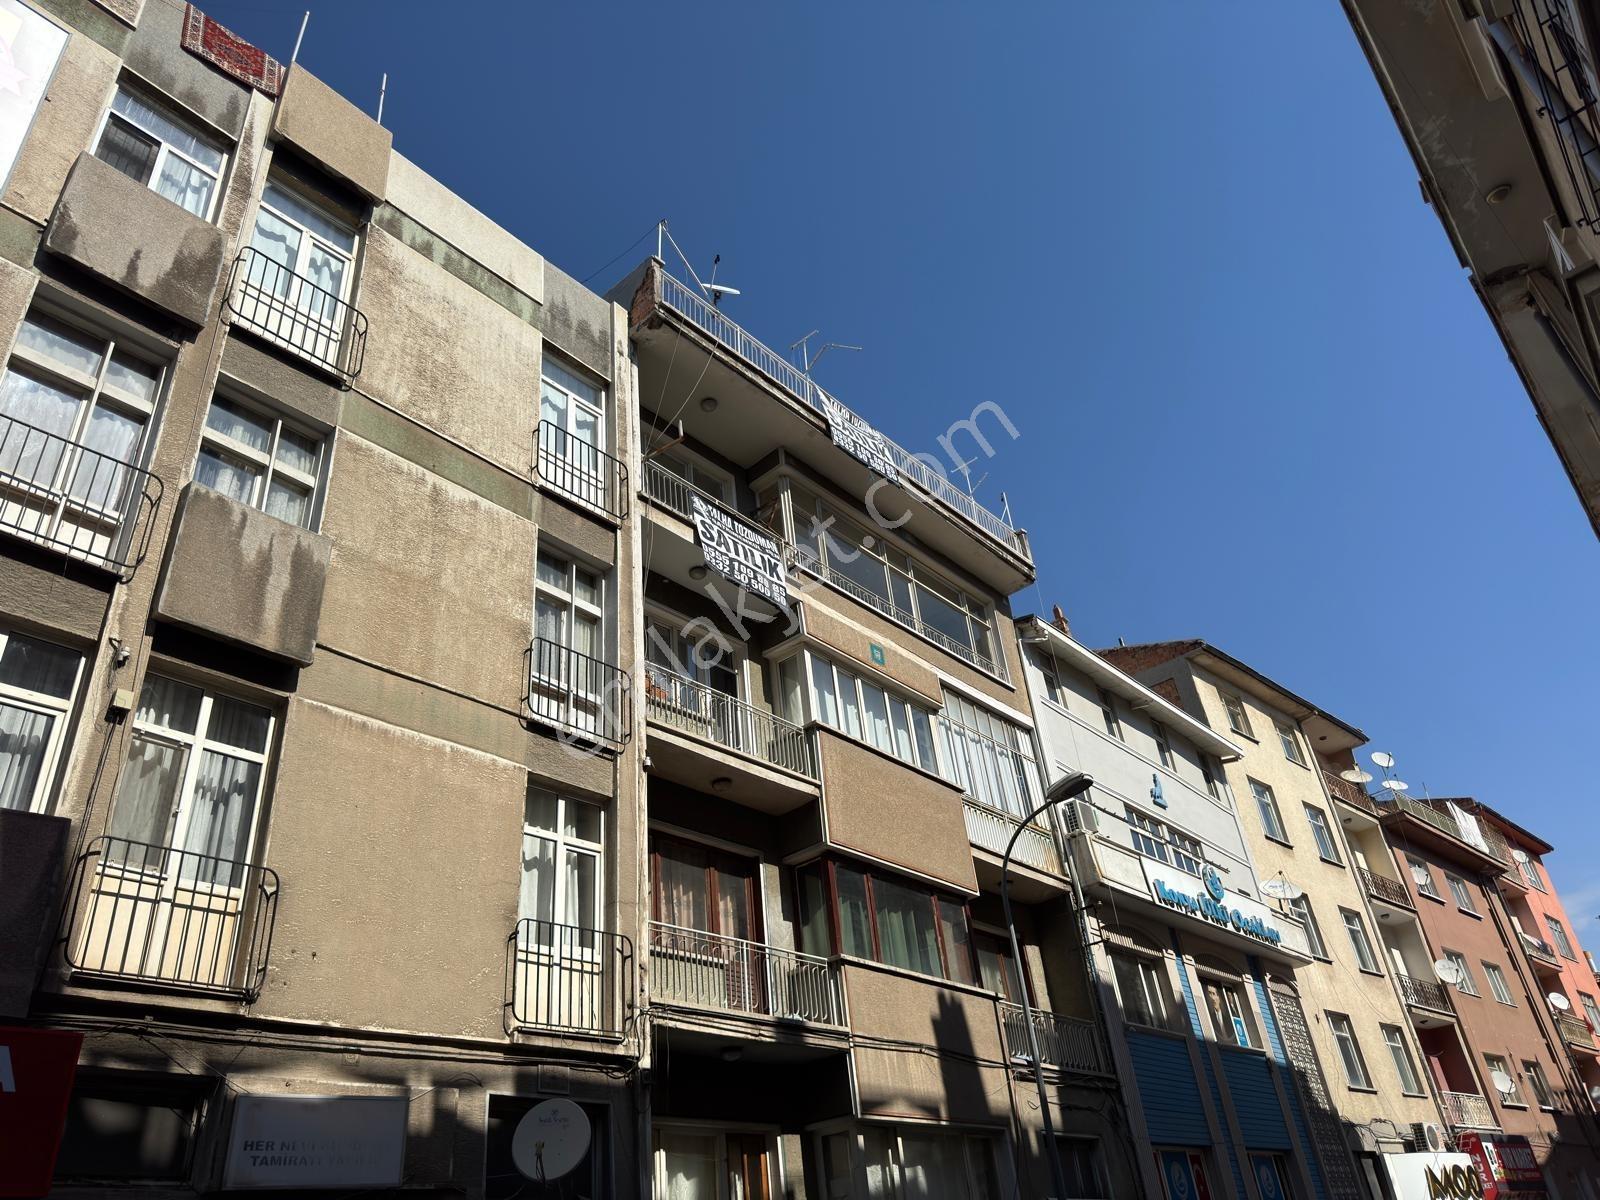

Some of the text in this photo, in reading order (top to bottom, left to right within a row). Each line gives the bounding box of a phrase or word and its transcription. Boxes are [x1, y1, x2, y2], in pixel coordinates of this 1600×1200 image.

[707, 504, 733, 531] TALHA
[699, 519, 783, 583] SATILIK
[1153, 879, 1199, 914] Konya
[243, 1140, 275, 1151] HER
